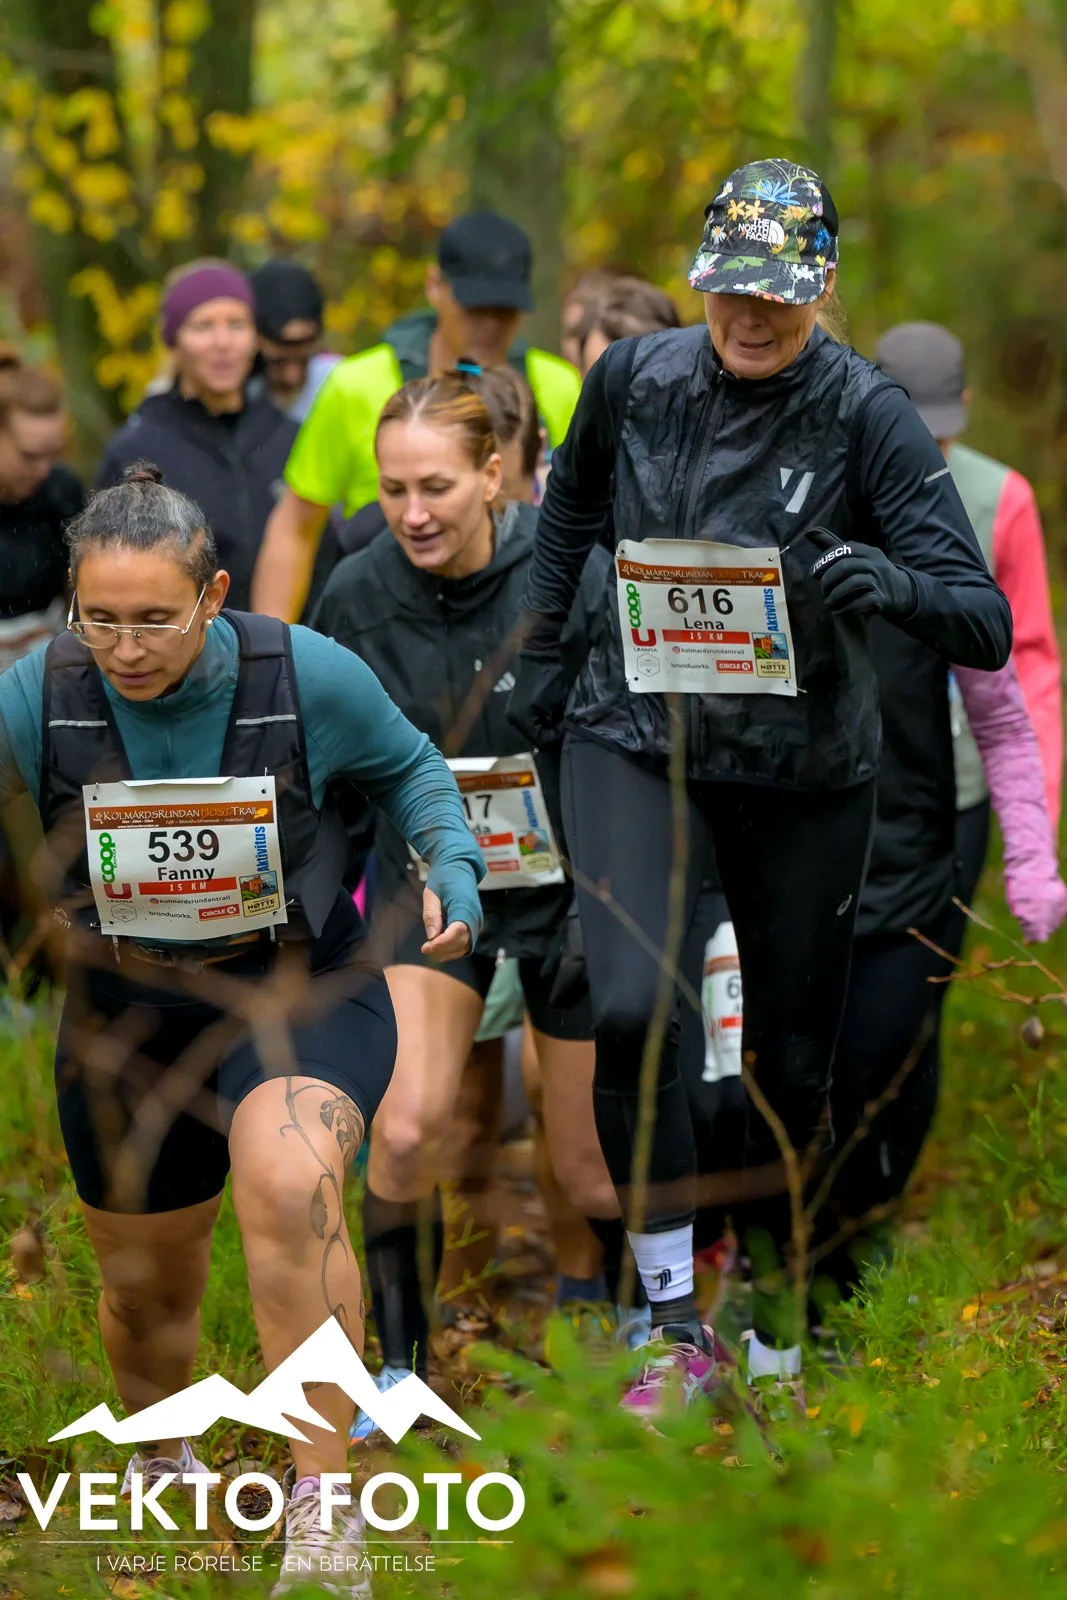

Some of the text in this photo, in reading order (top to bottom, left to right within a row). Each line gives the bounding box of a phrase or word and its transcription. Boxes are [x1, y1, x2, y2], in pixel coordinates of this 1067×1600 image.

[738, 223, 769, 235] NORTH
[753, 218, 770, 227] THE
[745, 233, 769, 242] FACE
[667, 587, 734, 616] 616
[763, 588, 779, 632] Aktivitus
[683, 617, 725, 630] Lena
[463, 794, 492, 820] 17
[99, 832, 116, 884] coop
[148, 829, 220, 863] 539
[254, 825, 270, 872] Aktivitus
[157, 867, 215, 882] Fanny
[201, 908, 226, 917] CIRCLE
[727, 975, 741, 999] 6
